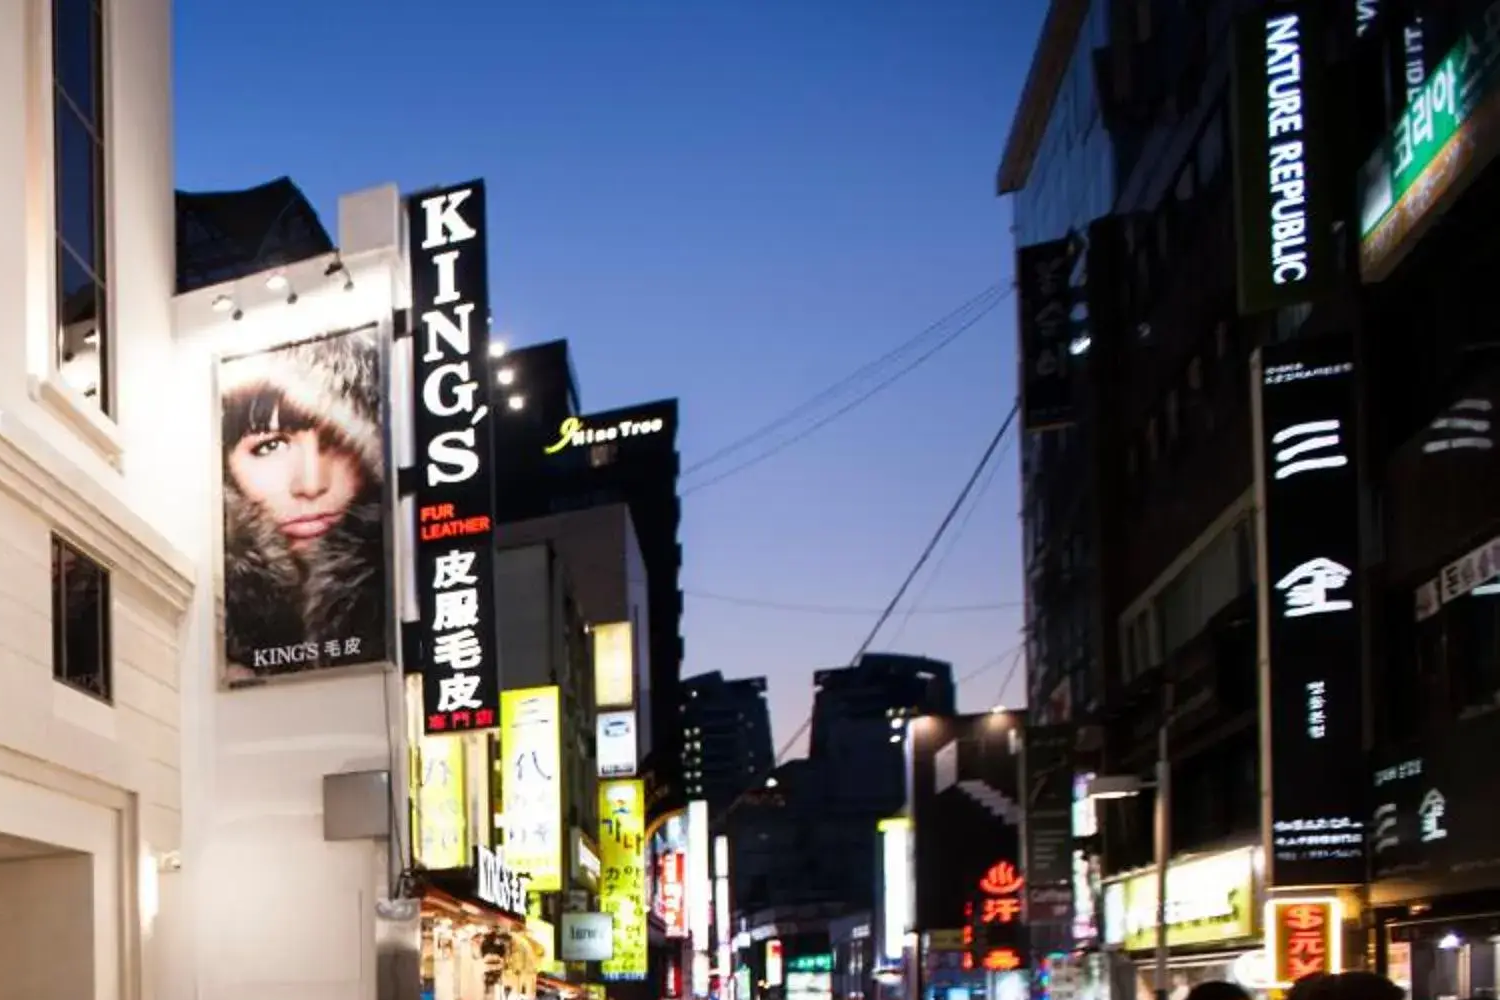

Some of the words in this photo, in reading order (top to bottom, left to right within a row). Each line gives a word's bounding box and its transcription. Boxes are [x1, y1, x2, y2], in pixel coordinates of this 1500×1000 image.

[1265, 14, 1302, 138] NATURE
[1268, 141, 1308, 285] REPUBLIC
[421, 188, 488, 487] KING'S
[619, 418, 663, 437] Tree
[420, 503, 454, 522] FUR
[421, 516, 491, 541] LEATHER
[253, 641, 319, 667] KING'S
